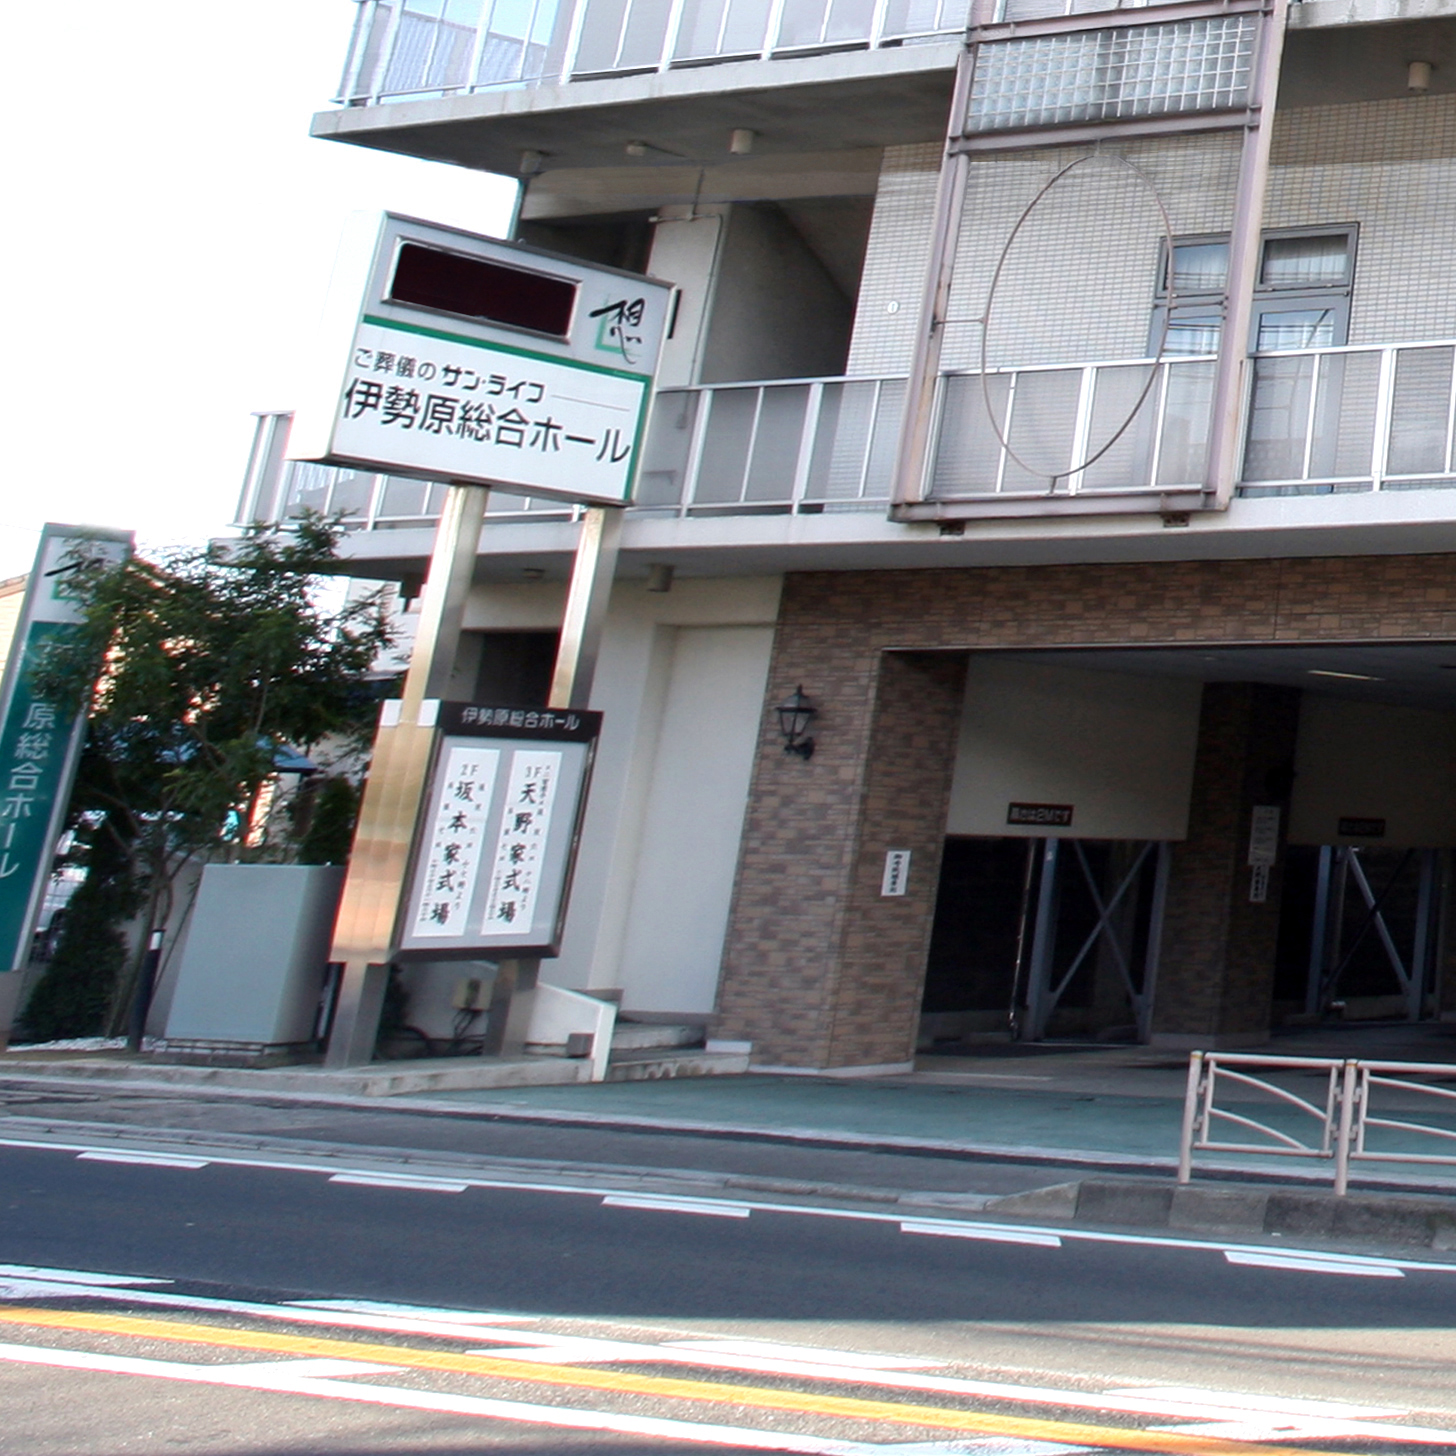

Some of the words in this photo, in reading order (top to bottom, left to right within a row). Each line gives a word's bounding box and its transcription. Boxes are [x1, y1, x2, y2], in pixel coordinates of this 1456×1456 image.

[343, 377, 631, 464] 伊勢原総合ホール
[461, 707, 580, 731] 伊勢原総合ホール
[460, 764, 479, 776] 2F
[525, 766, 542, 778] 3F
[430, 781, 475, 925] 坂本家式場
[496, 783, 537, 924] 天野家式場
